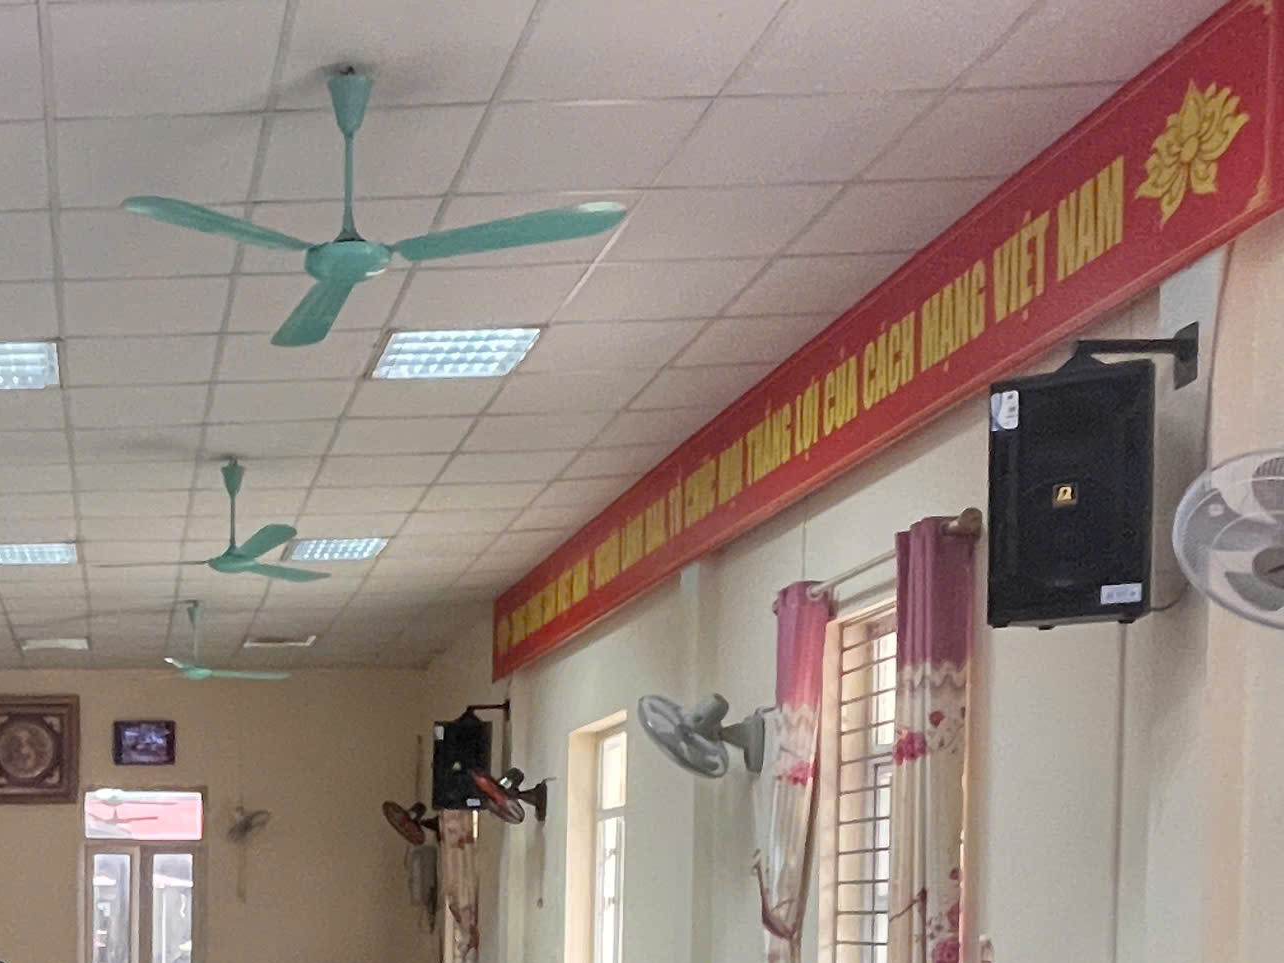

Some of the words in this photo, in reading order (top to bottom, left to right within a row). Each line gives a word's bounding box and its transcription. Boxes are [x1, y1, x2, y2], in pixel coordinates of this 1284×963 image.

[747, 400, 793, 486] THẮNG
[795, 376, 820, 461] LỢI
[823, 347, 858, 437] CỦA
[862, 311, 915, 410] CÁCH
[921, 259, 986, 372] MẠNG
[993, 210, 1050, 324] VIỆT
[1057, 156, 1125, 282] NAM
